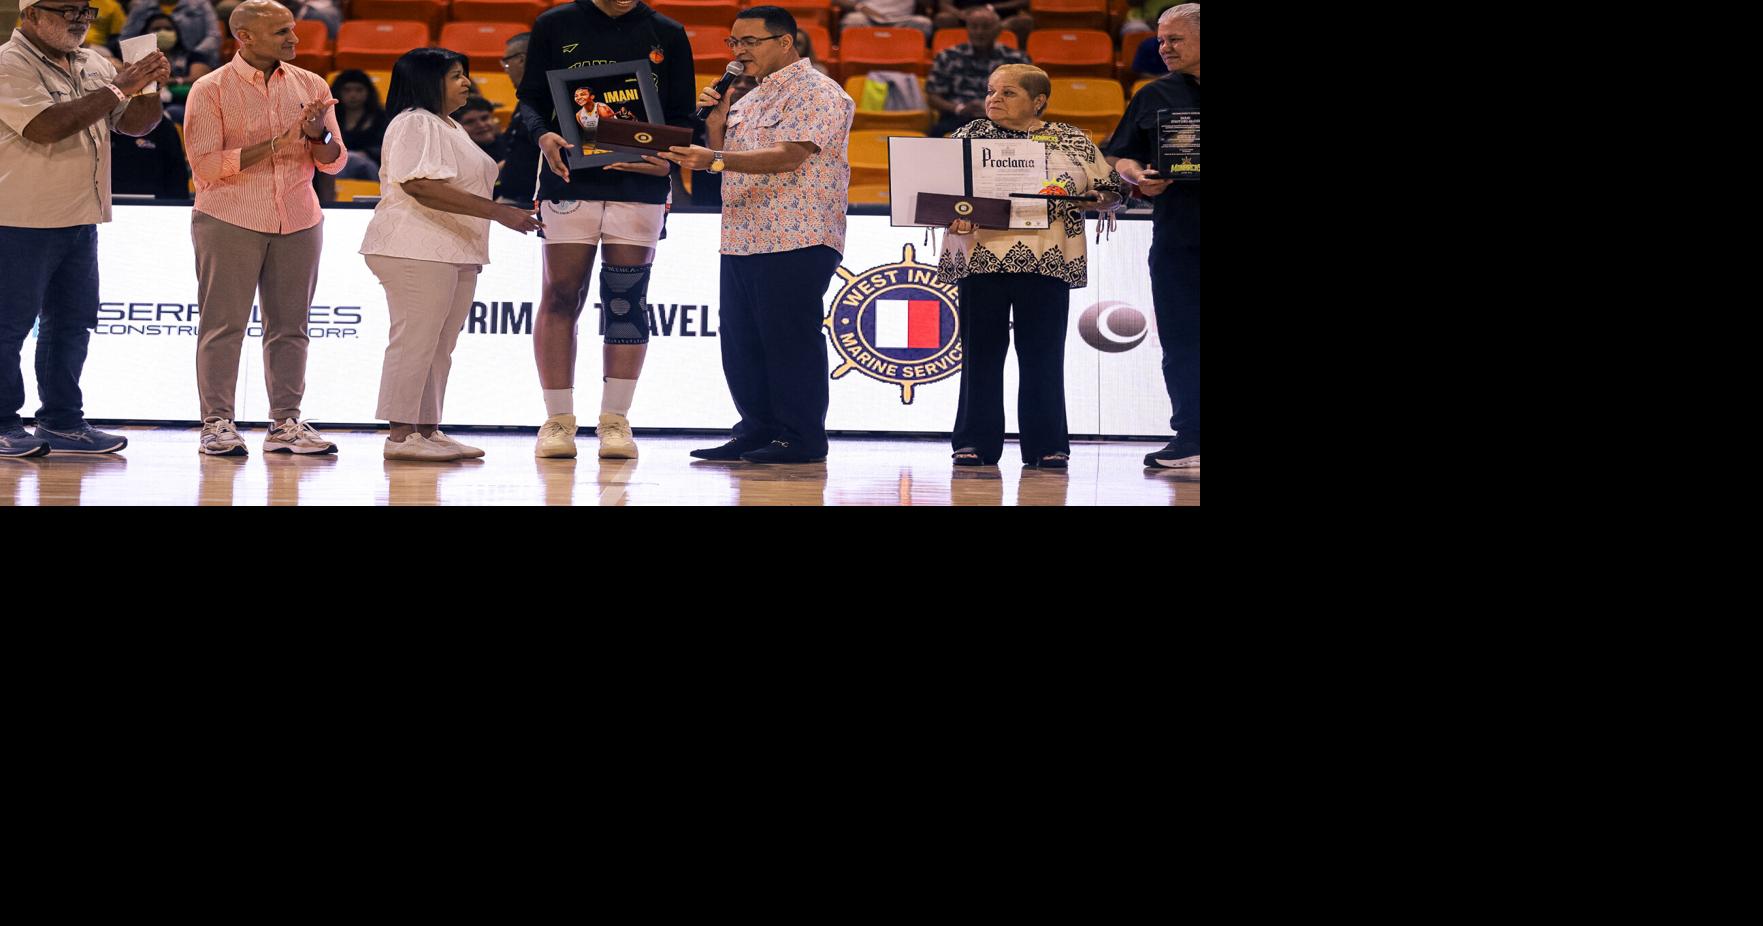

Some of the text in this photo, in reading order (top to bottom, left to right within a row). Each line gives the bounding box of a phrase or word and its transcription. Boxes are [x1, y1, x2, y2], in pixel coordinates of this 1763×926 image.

[603, 88, 640, 104] IMANI
[982, 147, 1035, 168] Proclama
[843, 269, 960, 308] WEST INDIE
[307, 326, 360, 338] ORP.
[465, 301, 720, 337] RIM TAVEL
[839, 331, 898, 377] MARINE
